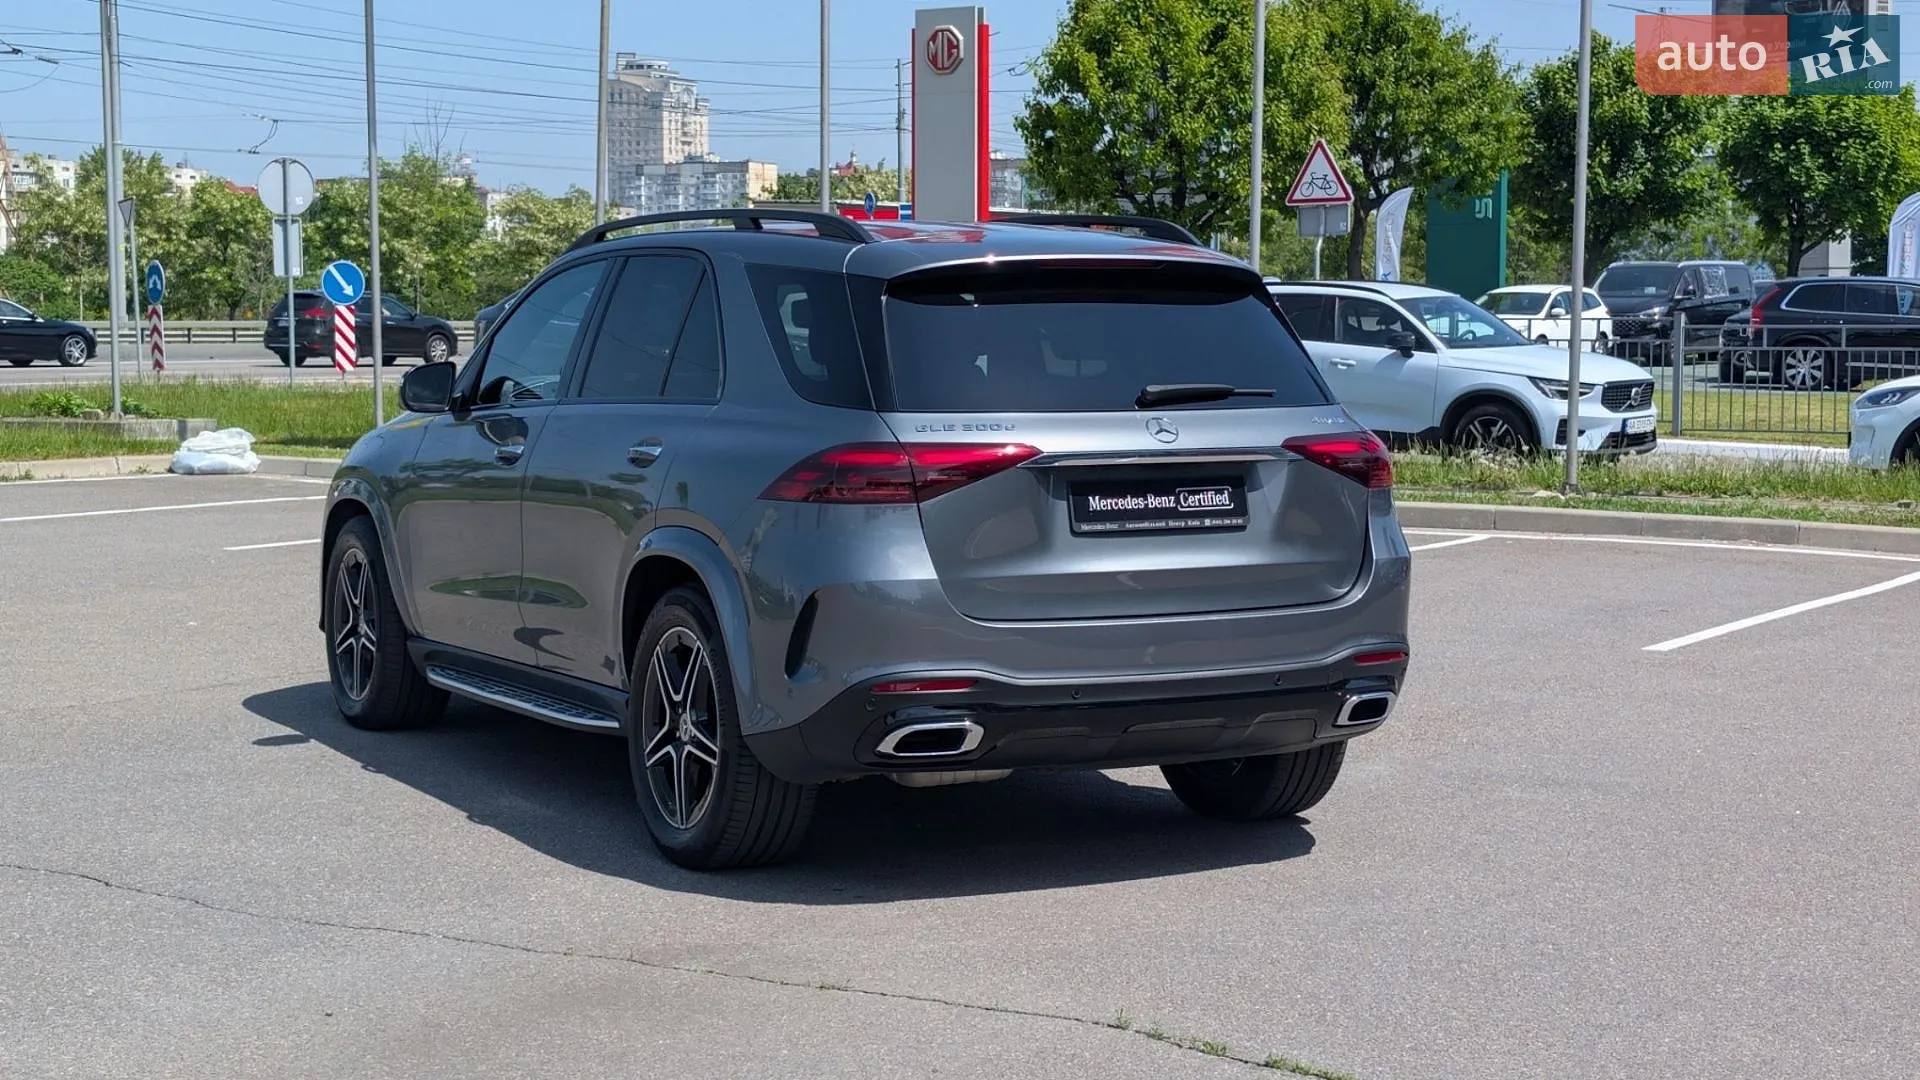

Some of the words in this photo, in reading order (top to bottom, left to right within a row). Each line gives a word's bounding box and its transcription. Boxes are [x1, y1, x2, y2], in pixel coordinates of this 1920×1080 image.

[928, 31, 958, 68] MG
[914, 423, 957, 432] GLE
[1088, 493, 1176, 511] Mercedes-Benz
[1179, 490, 1229, 507] Certified
